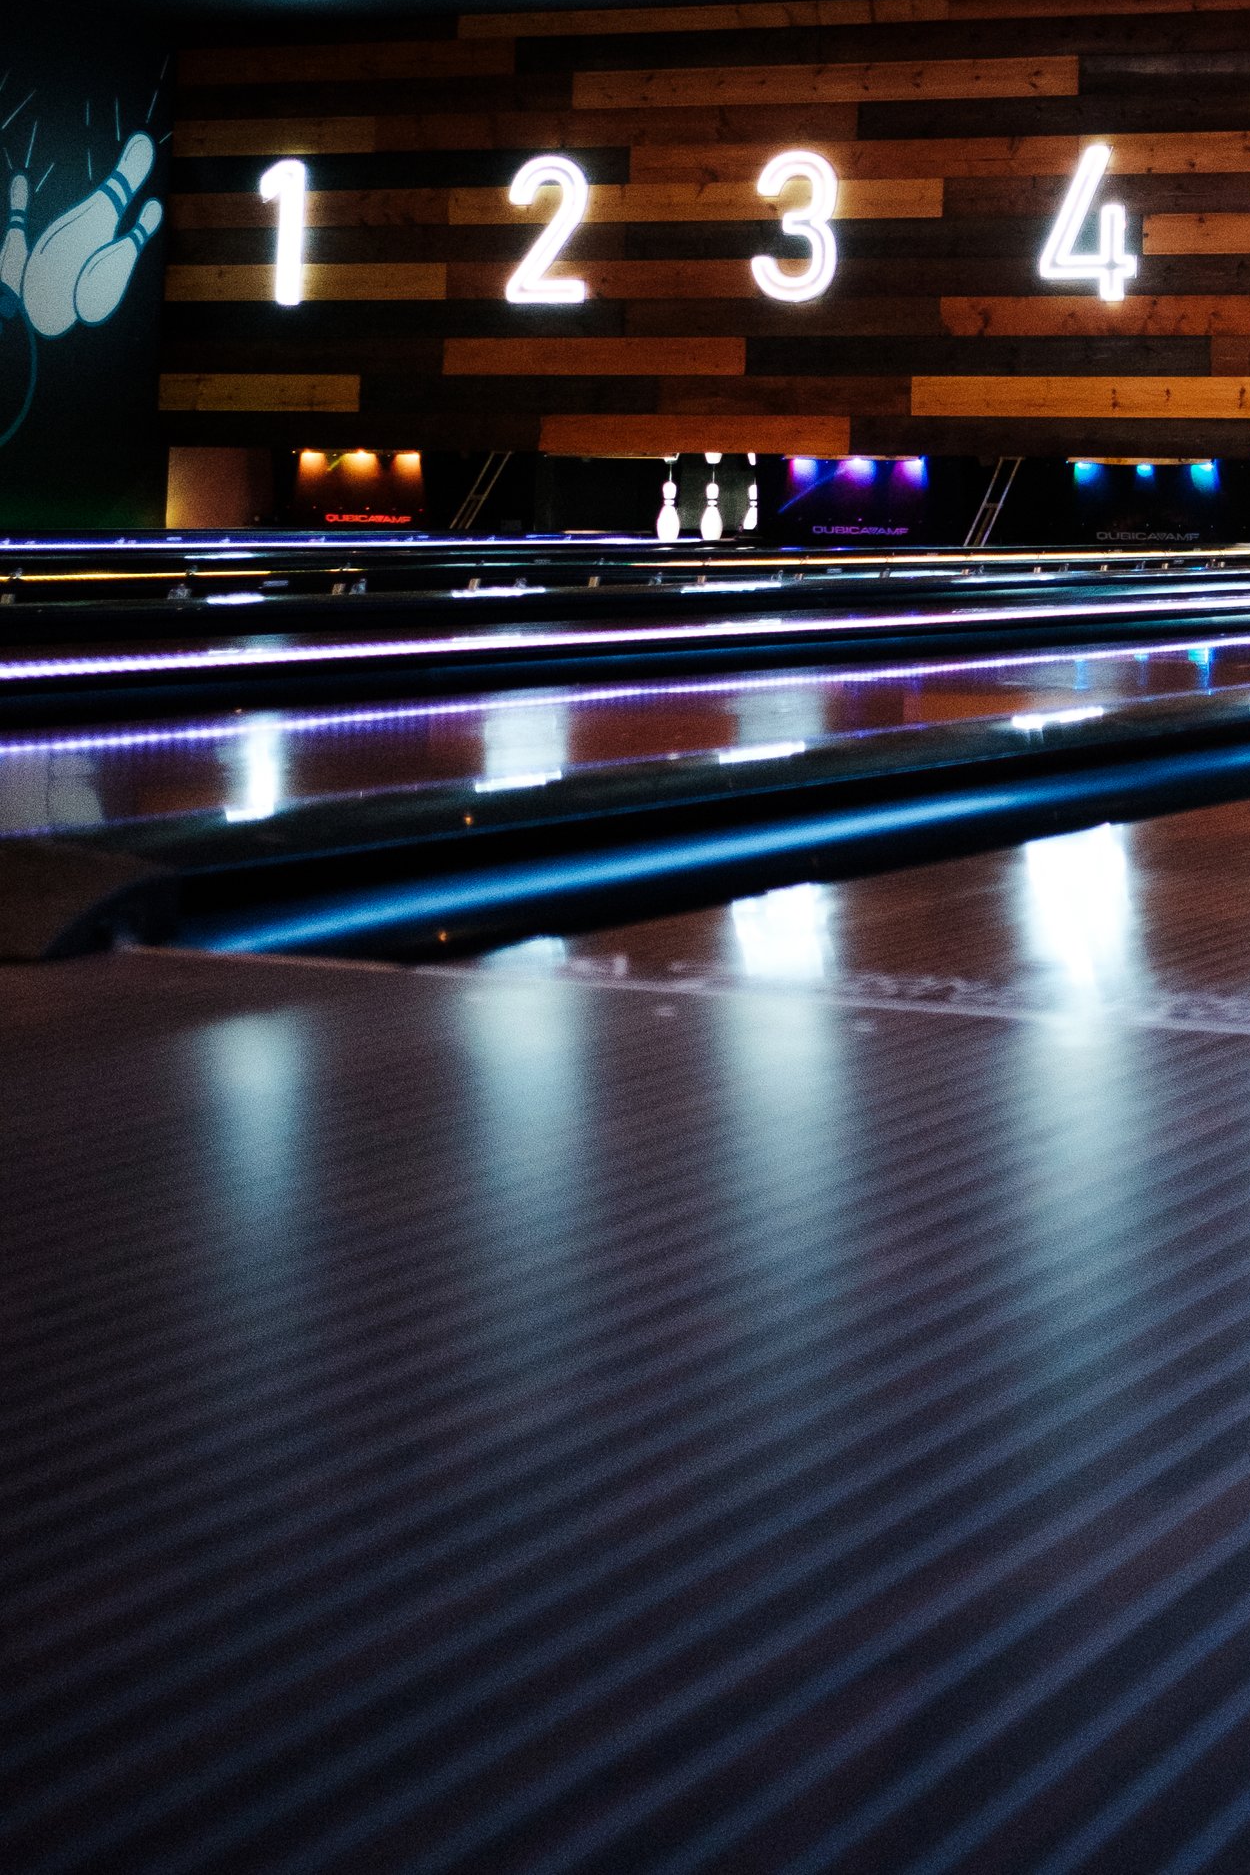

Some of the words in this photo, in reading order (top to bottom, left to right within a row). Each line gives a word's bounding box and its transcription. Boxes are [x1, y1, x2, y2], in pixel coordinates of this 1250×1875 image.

[258, 158, 308, 306] 1
[504, 154, 589, 304] 2
[750, 149, 838, 303] 3
[1038, 141, 1138, 302] 4
